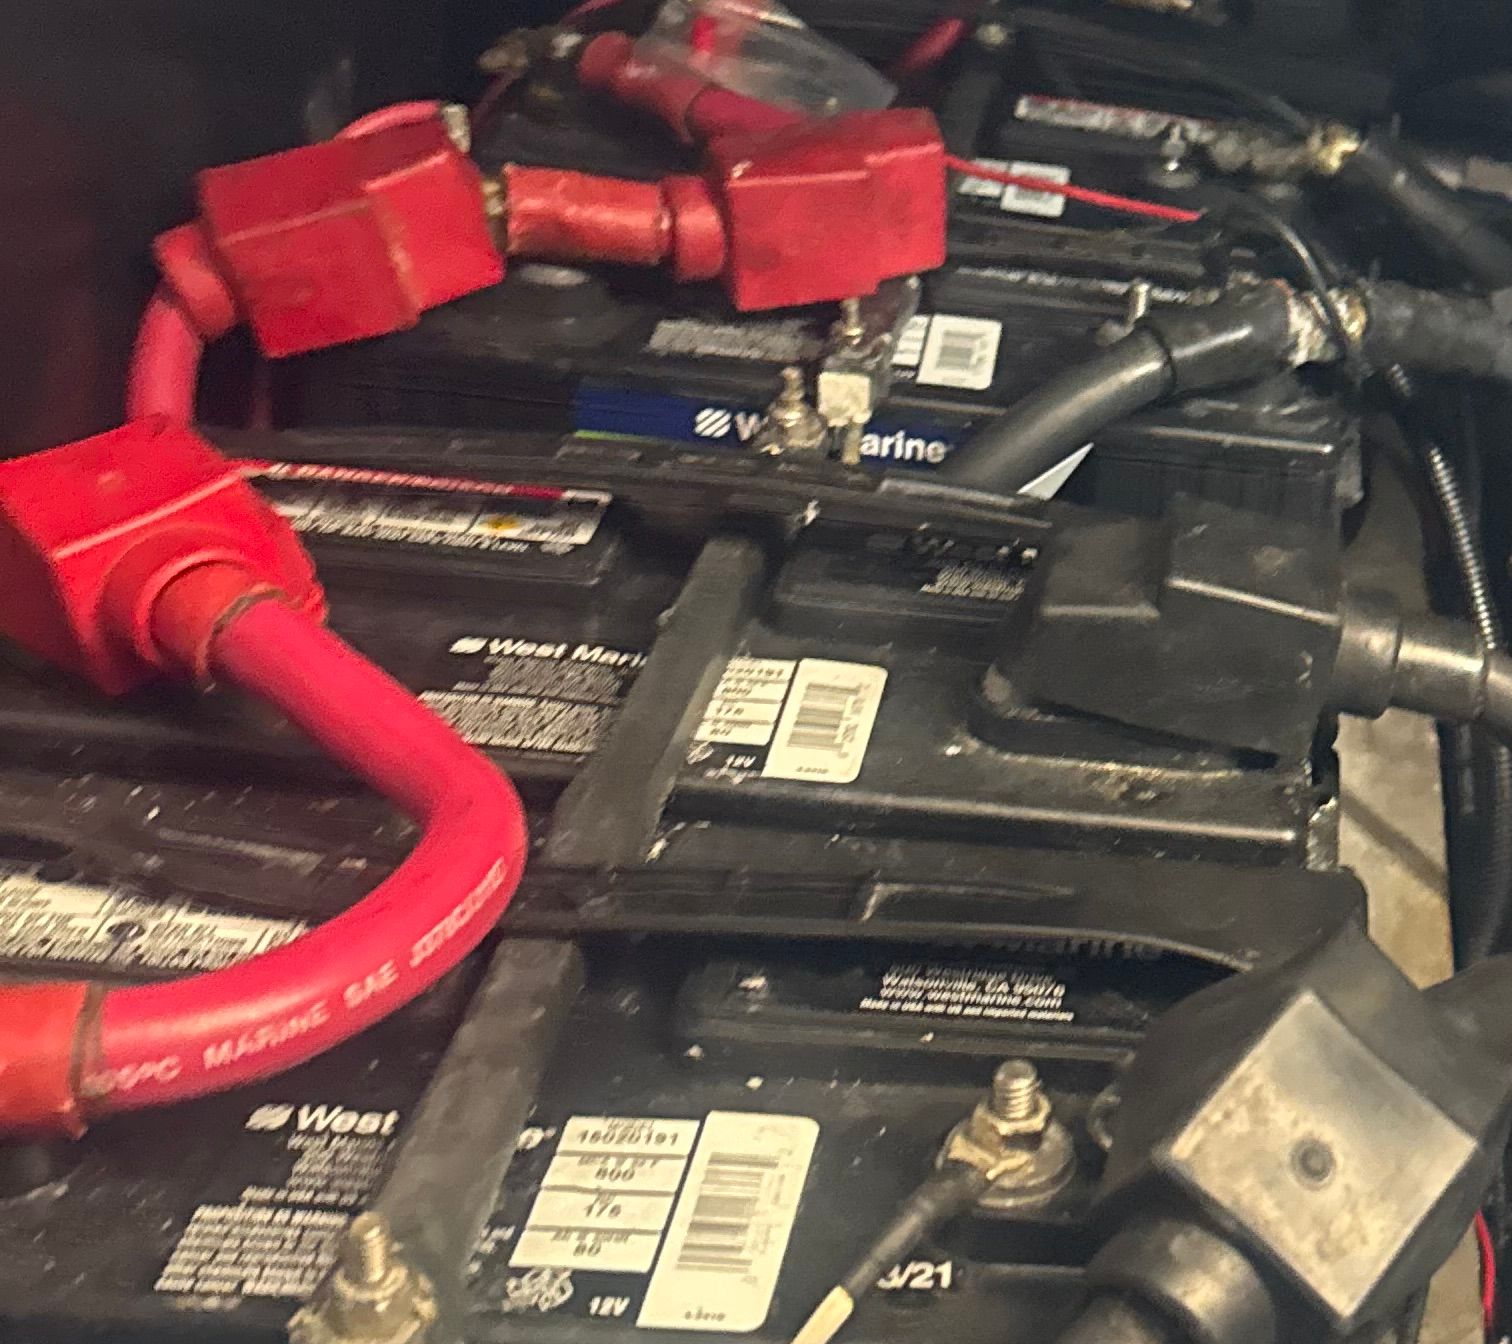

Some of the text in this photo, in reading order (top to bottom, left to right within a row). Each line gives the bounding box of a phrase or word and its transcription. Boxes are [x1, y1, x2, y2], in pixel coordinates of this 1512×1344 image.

[860, 430, 946, 463] arine
[489, 637, 568, 659] West
[297, 1103, 400, 1137] West
